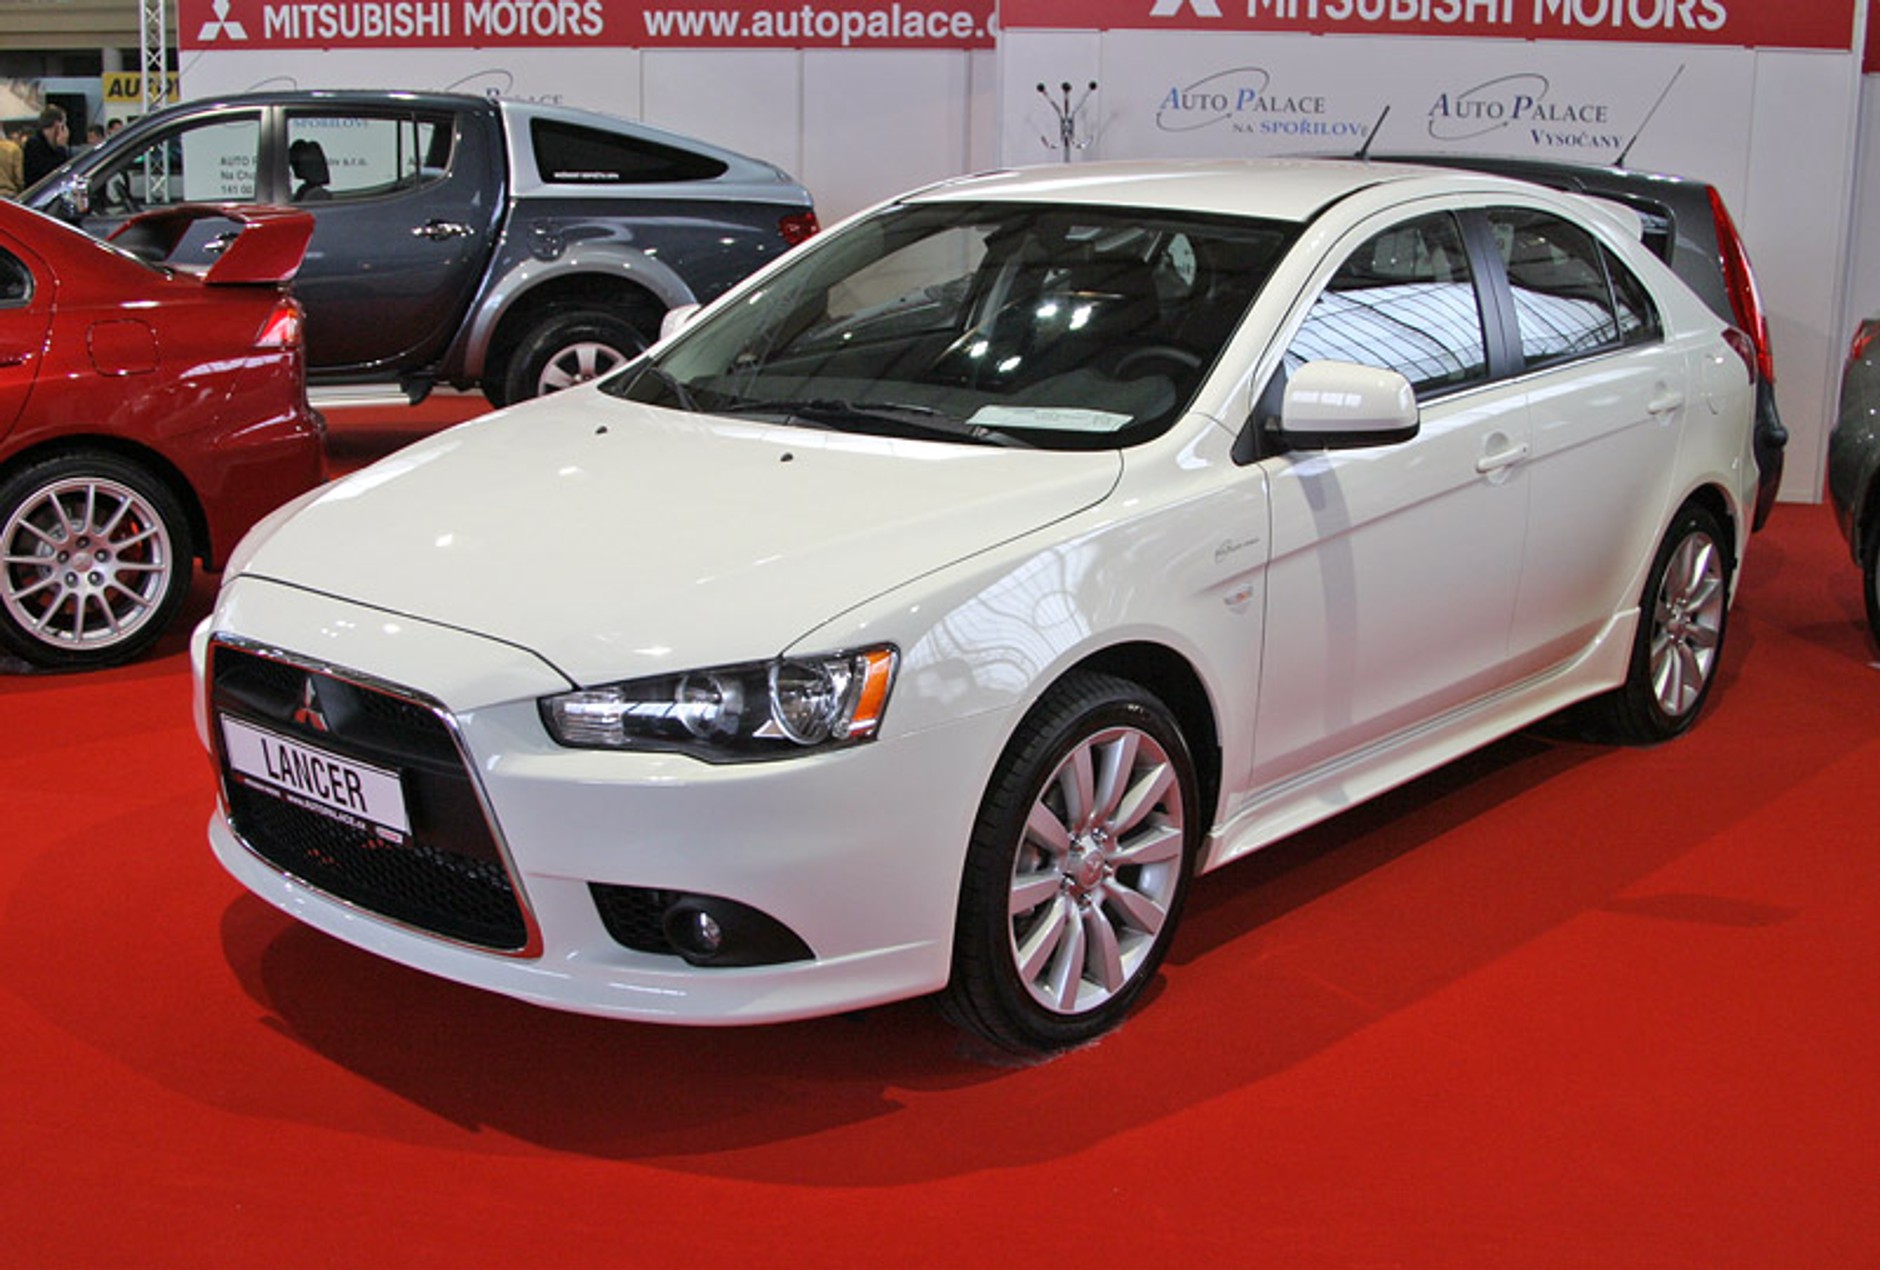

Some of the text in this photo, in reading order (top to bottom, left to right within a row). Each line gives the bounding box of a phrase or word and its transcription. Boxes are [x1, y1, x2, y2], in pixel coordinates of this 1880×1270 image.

[263, 0, 604, 39] MITSUBISHI MOTORS
[1160, 87, 1325, 114] AUTO PALACE
[1429, 93, 1608, 123] AUTO PALACE
[261, 738, 368, 813] LANCER
